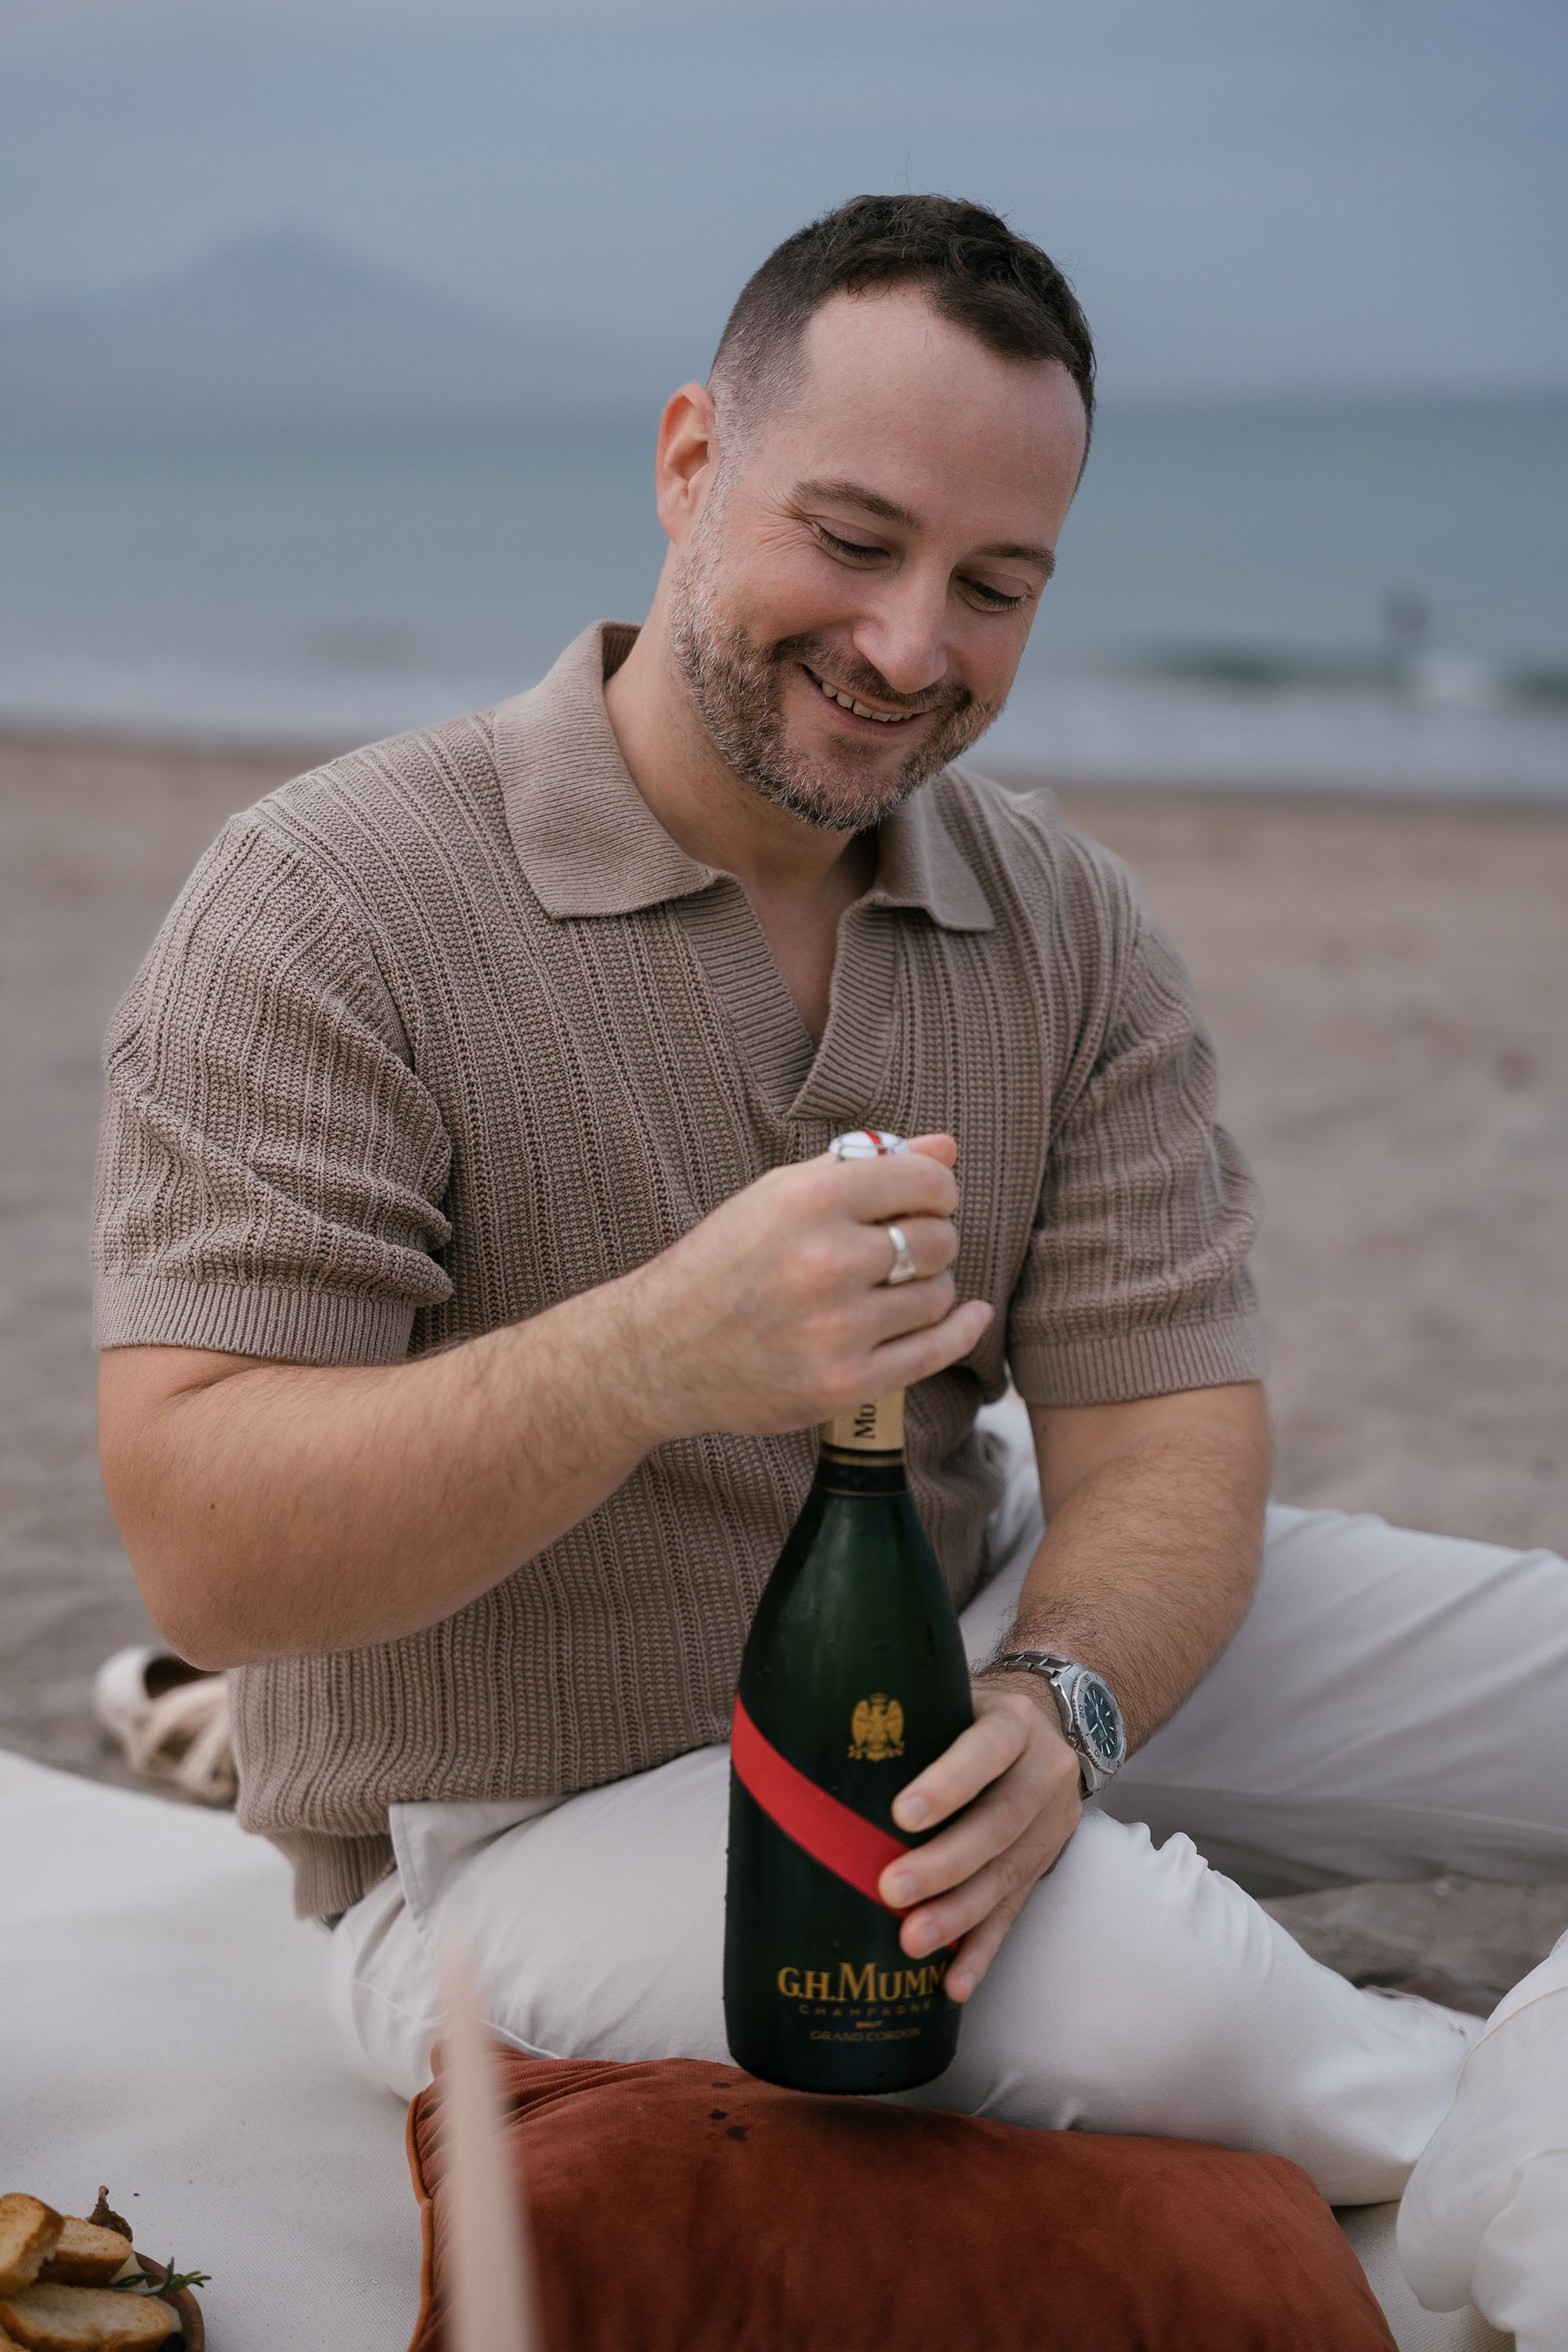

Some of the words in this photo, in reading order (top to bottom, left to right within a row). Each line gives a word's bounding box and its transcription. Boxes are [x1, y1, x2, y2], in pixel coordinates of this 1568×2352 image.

[1083, 1674, 1091, 1683] 30
[1078, 1704, 1085, 1719] 20
[1094, 1749, 1101, 1759] 10
[798, 2001, 931, 2017] CHAMPAGNE
[810, 2029, 863, 2042] GRAND
[866, 2027, 922, 2042] CORDON
